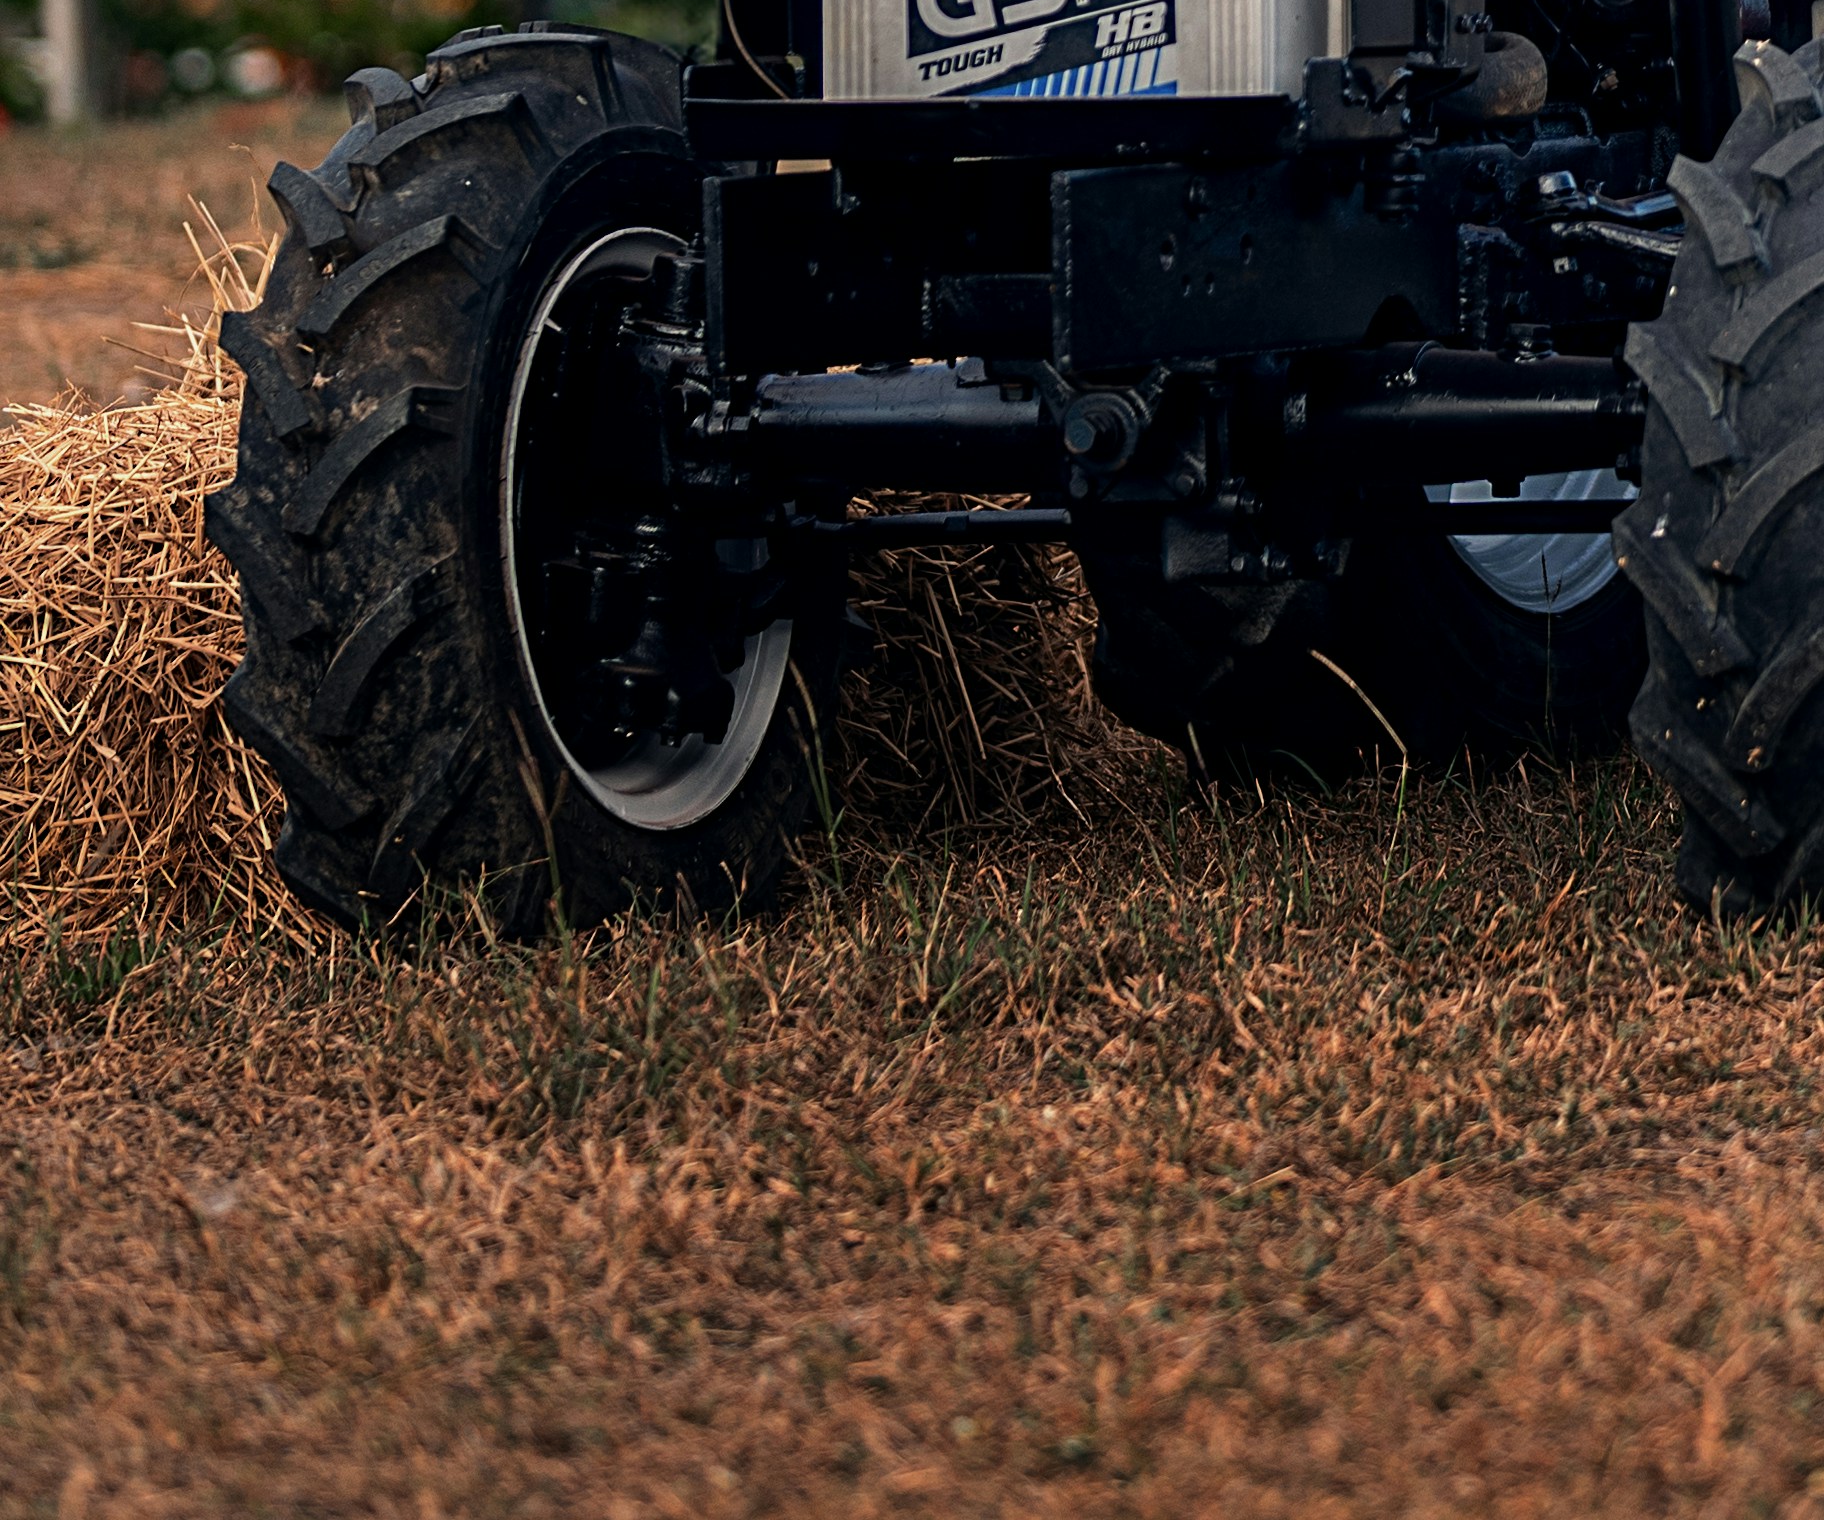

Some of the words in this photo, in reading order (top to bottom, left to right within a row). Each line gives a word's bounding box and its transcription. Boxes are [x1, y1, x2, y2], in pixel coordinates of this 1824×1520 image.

[1095, 2, 1167, 48] HB
[1126, 33, 1167, 53] HYBRID
[918, 44, 1004, 81] TOUGH
